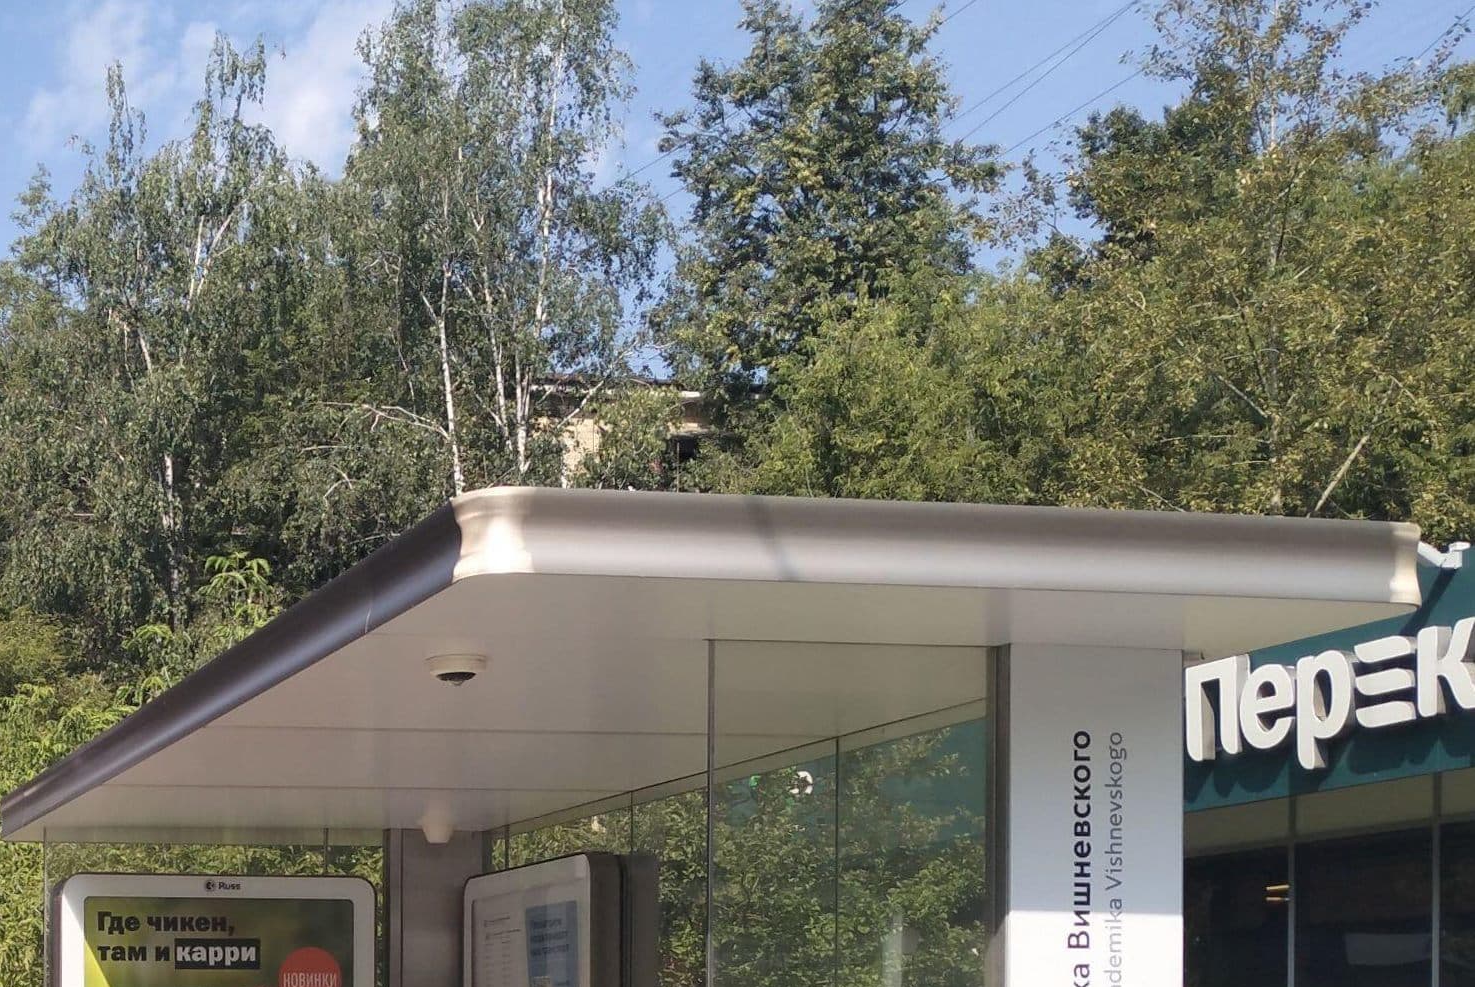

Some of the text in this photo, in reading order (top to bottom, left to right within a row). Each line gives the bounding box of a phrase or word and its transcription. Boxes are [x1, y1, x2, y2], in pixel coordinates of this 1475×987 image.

[1104, 732, 1128, 891] Vishnevskogo
[1067, 730, 1091, 949] Вишневского
[218, 881, 241, 890] Russ
[97, 911, 235, 936] Где чикен,
[97, 944, 257, 967] там и карри
